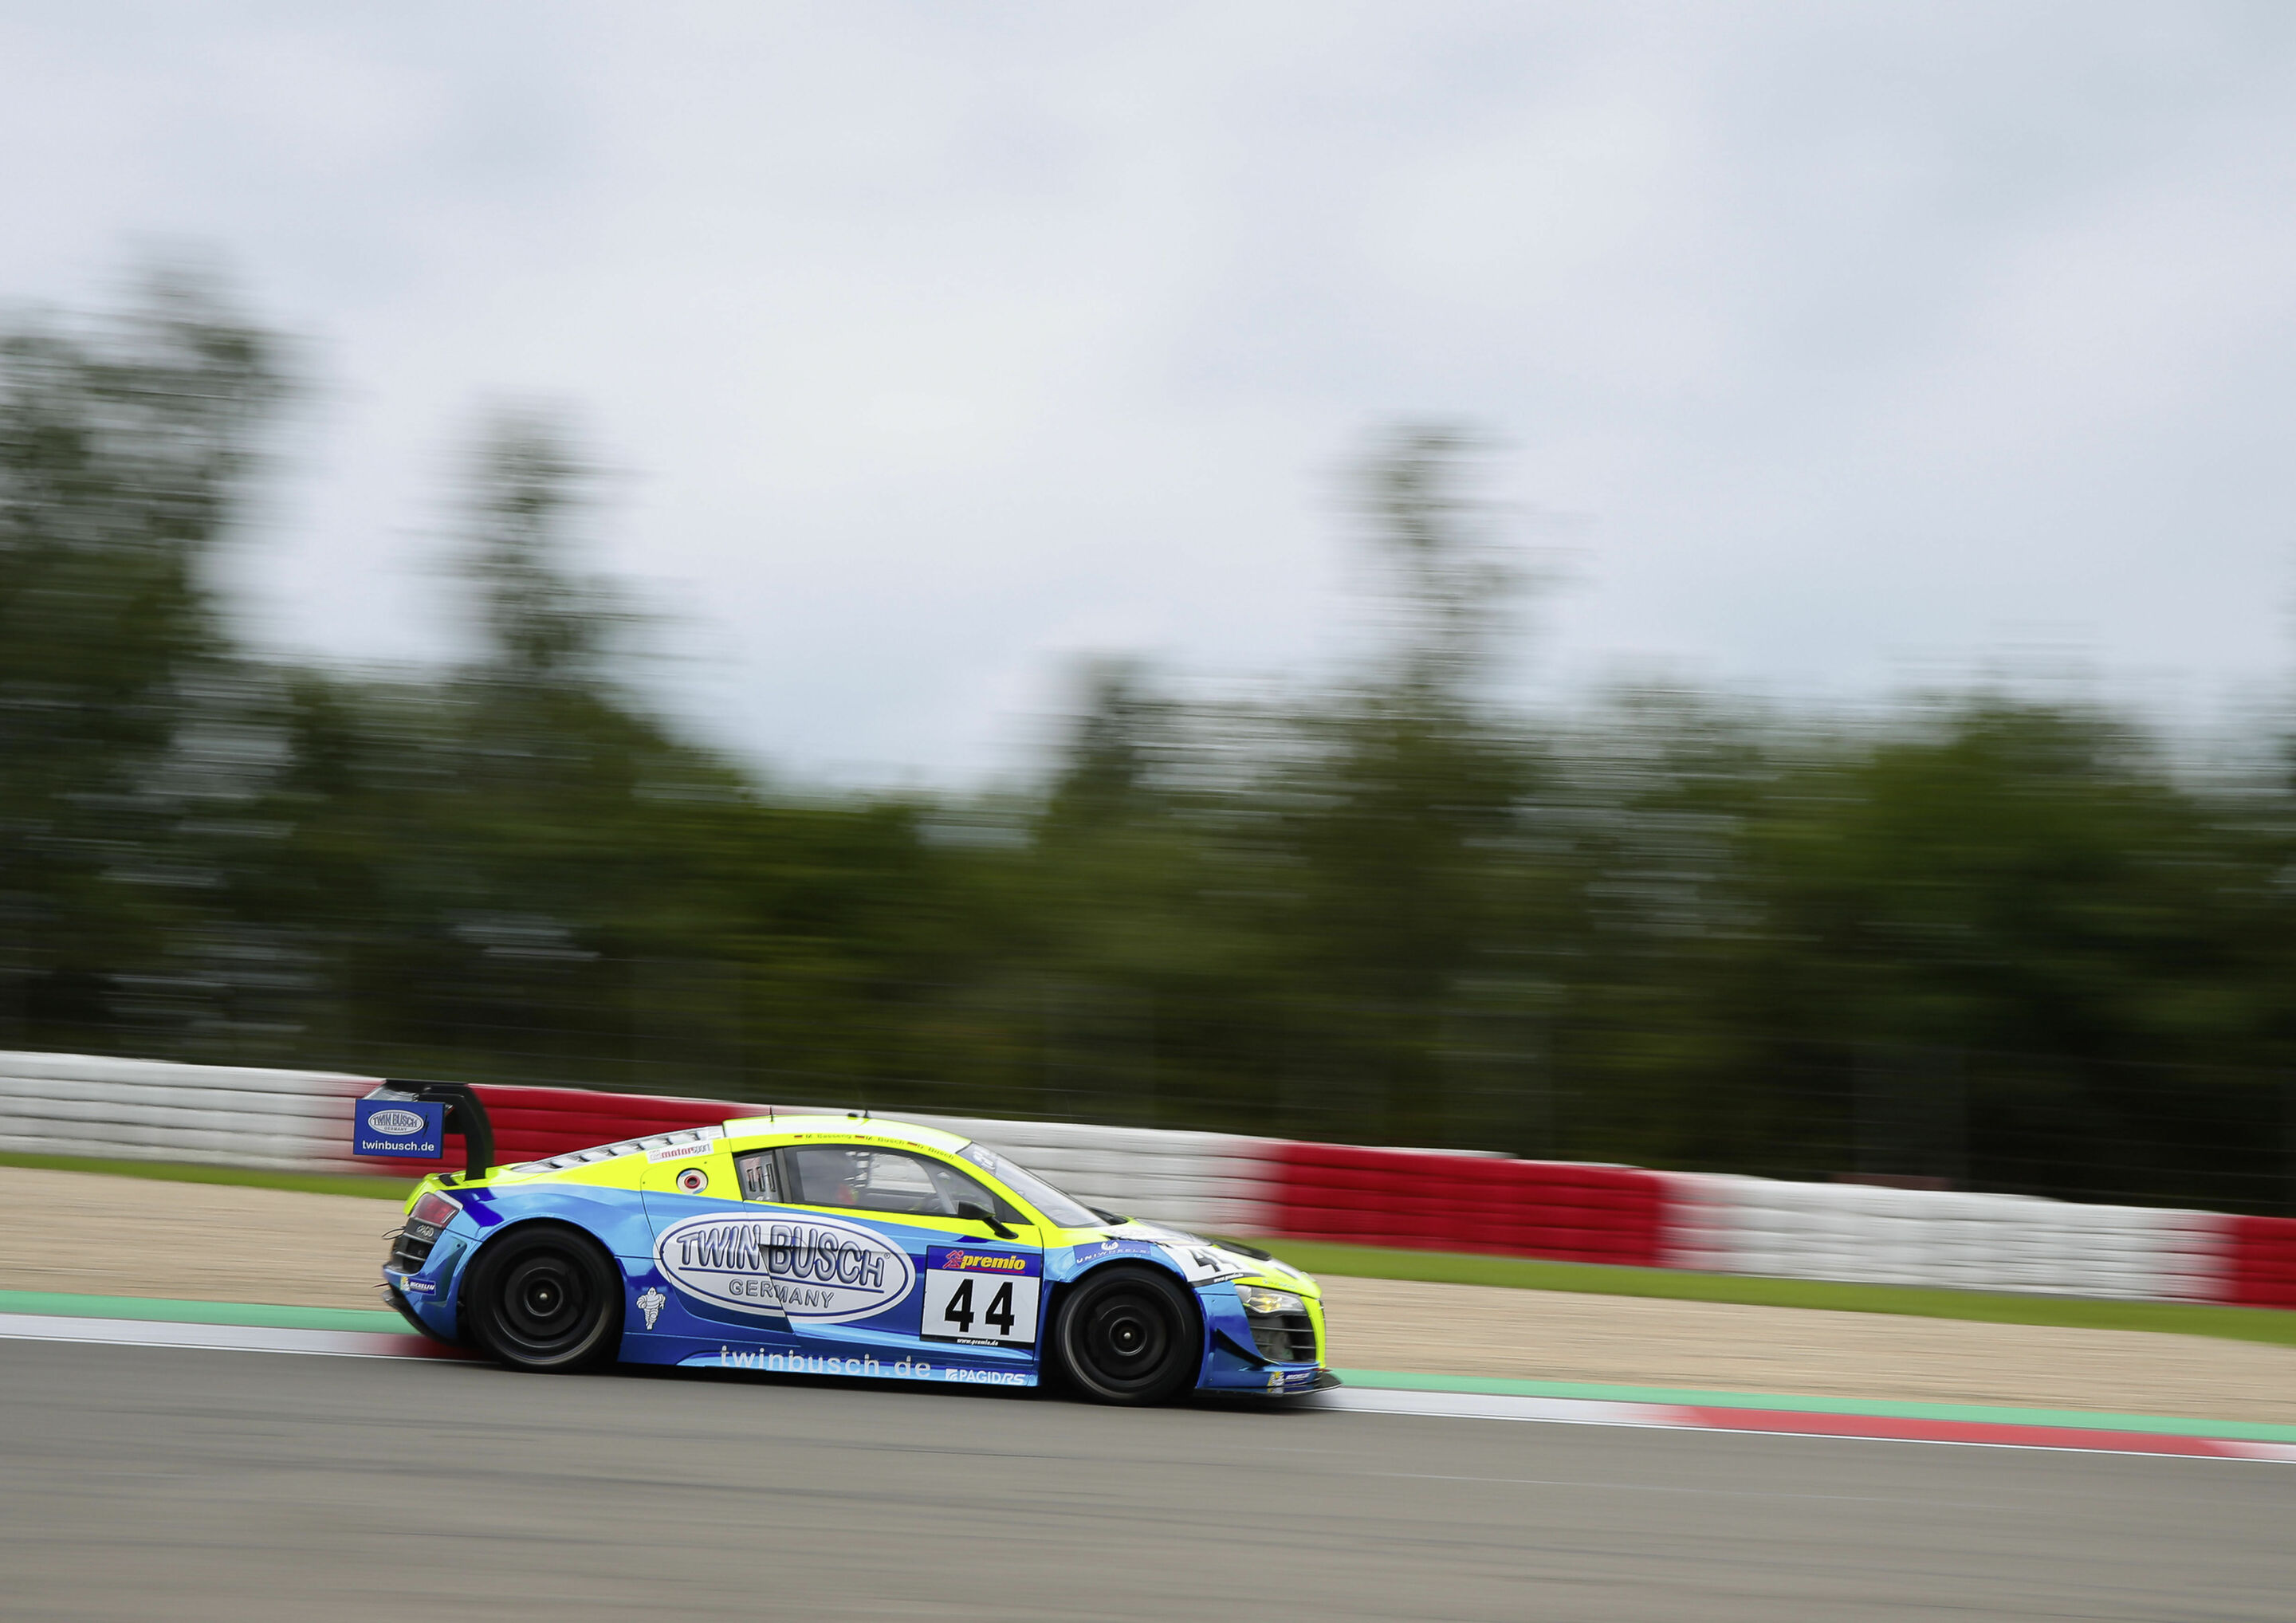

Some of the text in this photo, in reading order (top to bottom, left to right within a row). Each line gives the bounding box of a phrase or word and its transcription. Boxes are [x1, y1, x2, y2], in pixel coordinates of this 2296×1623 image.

[372, 1113, 418, 1128] TWIN BUSCH
[362, 1140, 434, 1151] twinbusch.de
[677, 1224, 885, 1287] TWIN BUSCH
[960, 1255, 1026, 1270] premio
[729, 1279, 834, 1308] GERMANY
[944, 1279, 1015, 1336] 44
[720, 1346, 931, 1377] twinbusch.de
